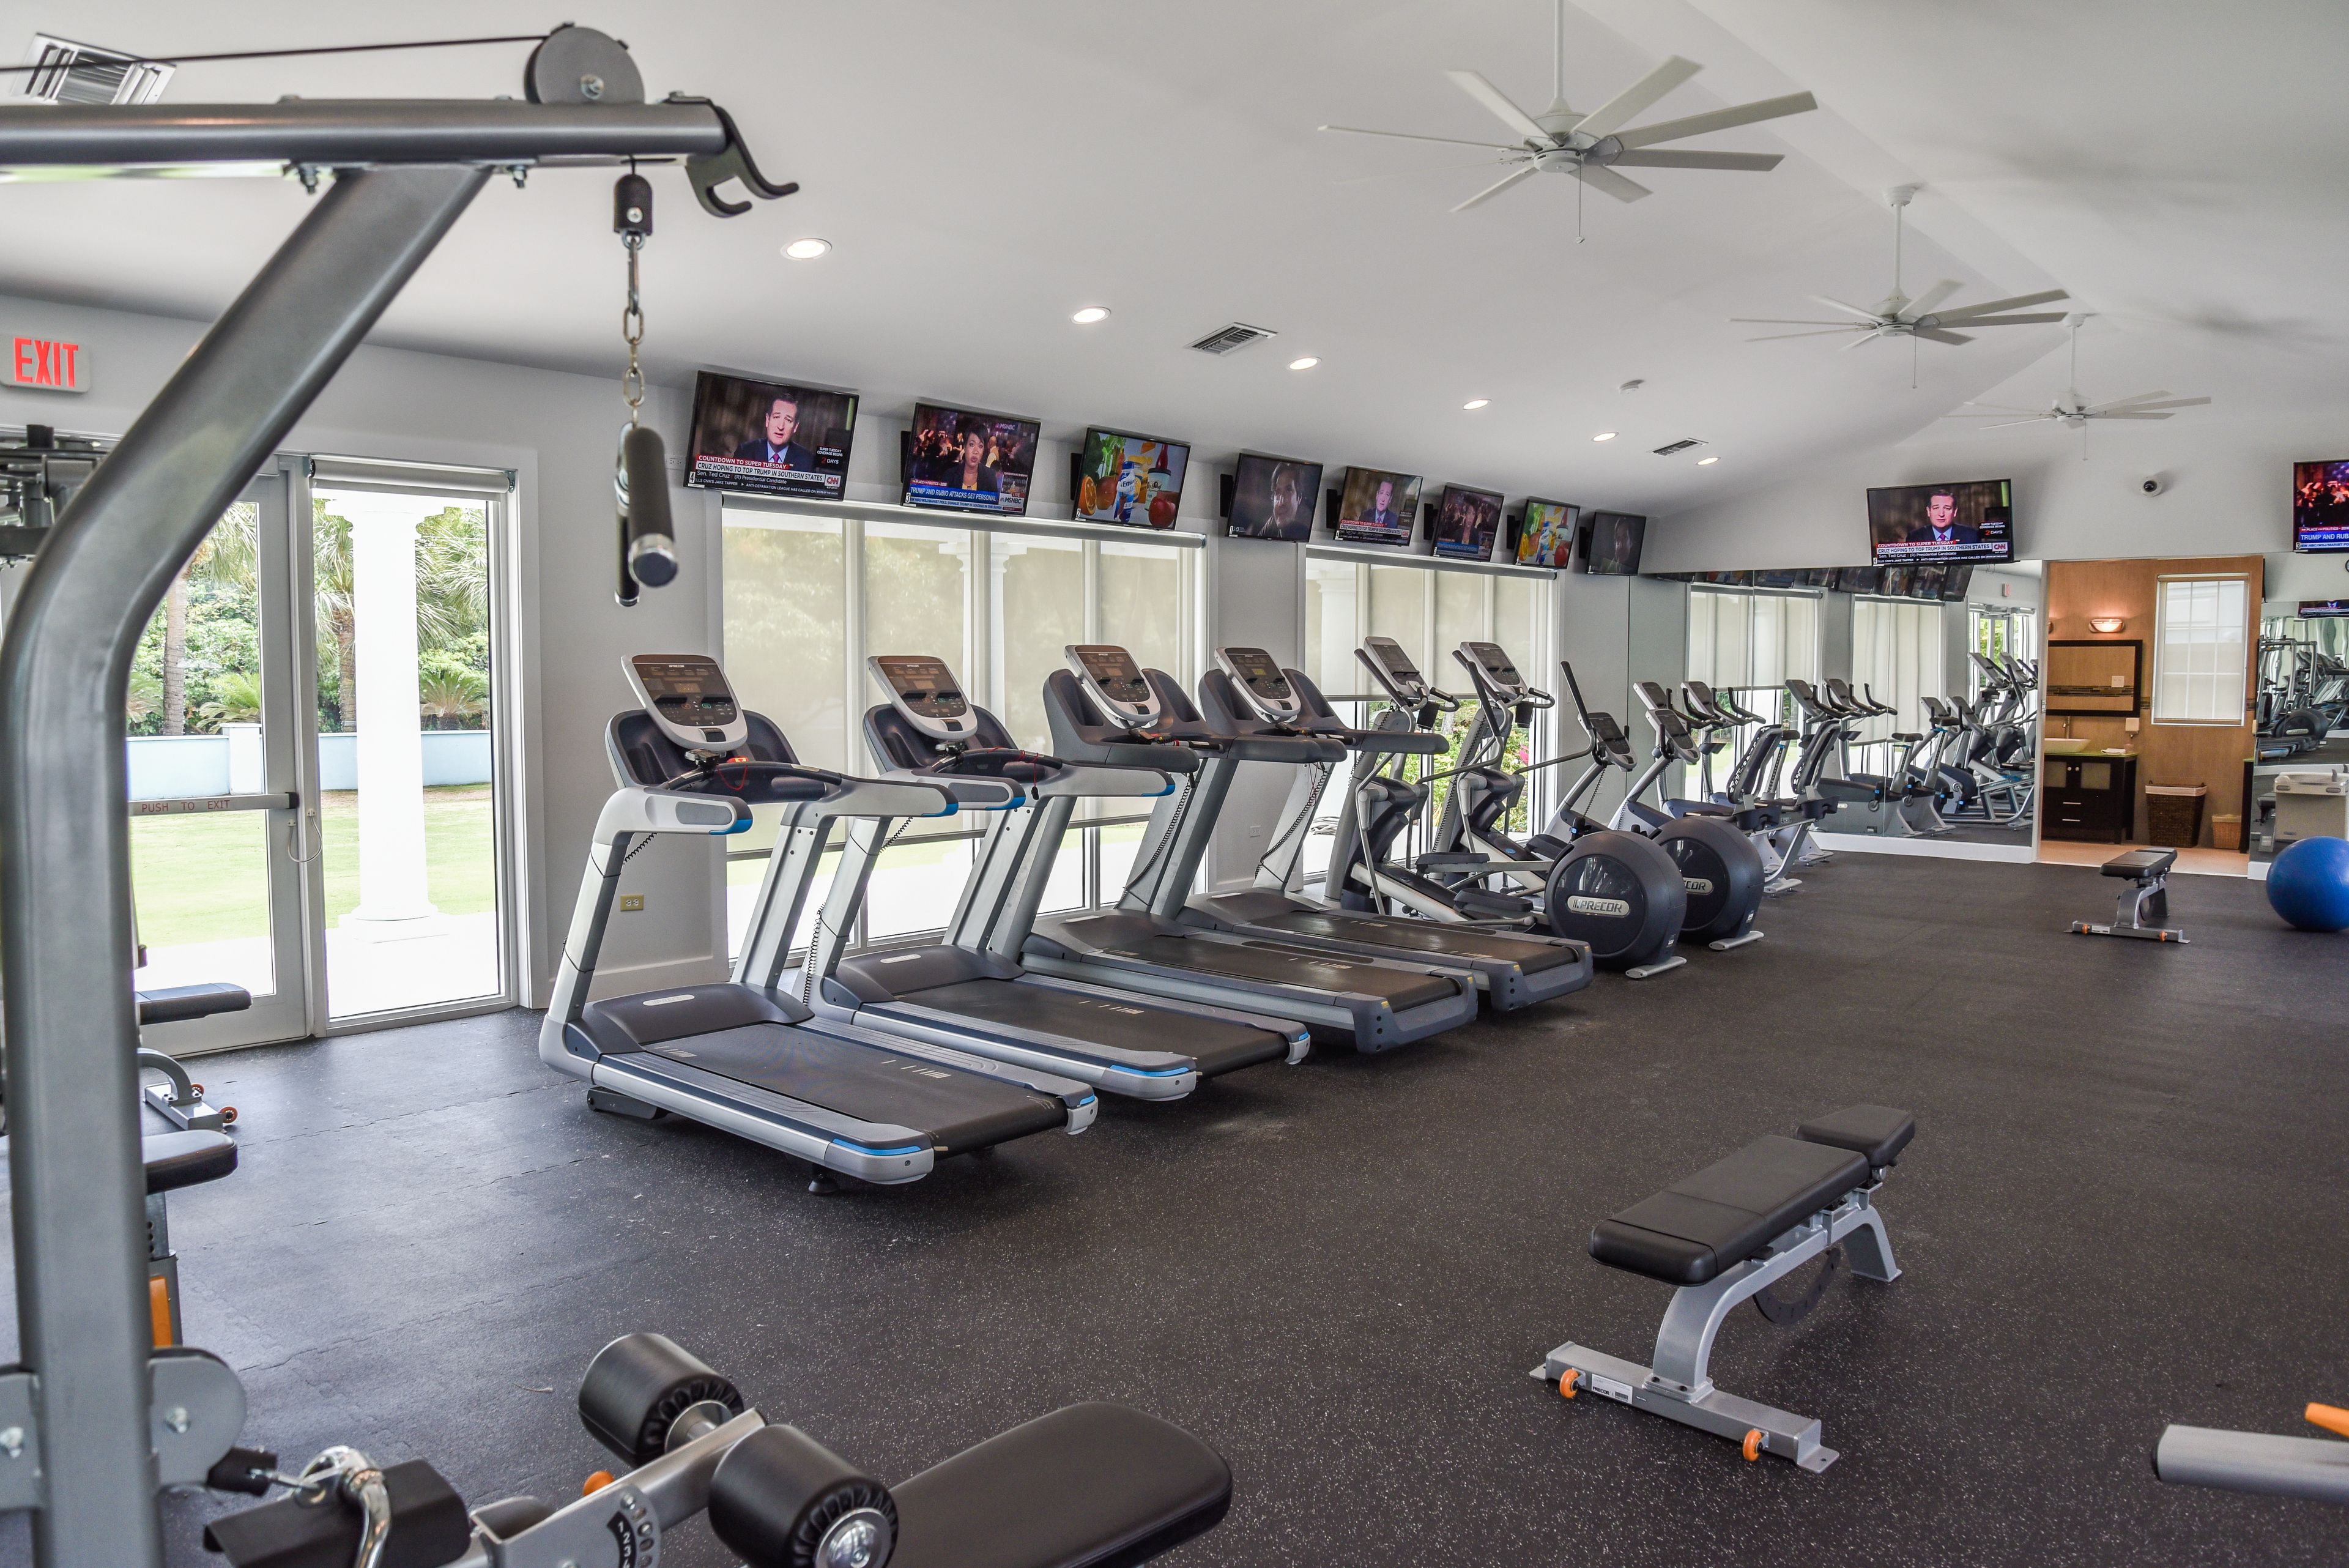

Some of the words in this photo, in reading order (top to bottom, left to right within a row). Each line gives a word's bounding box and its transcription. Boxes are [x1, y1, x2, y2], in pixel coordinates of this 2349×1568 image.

[14, 338, 79, 387] EXIT
[699, 455, 735, 464] COUNTDOWN
[689, 472, 694, 483] 4
[777, 470, 804, 479] SOUTHERN
[826, 477, 839, 485] CNN
[906, 493, 910, 502] 3
[141, 802, 169, 812] PUSH
[180, 801, 195, 811] TO
[207, 800, 230, 809] EXIT
[1683, 880, 1706, 891] COR
[1580, 899, 1622, 913] PRECOR
[1592, 1386, 1609, 1395] PRECOR
[618, 1520, 624, 1533] 1
[623, 1531, 631, 1545] 2
[624, 1544, 631, 1558] 3
